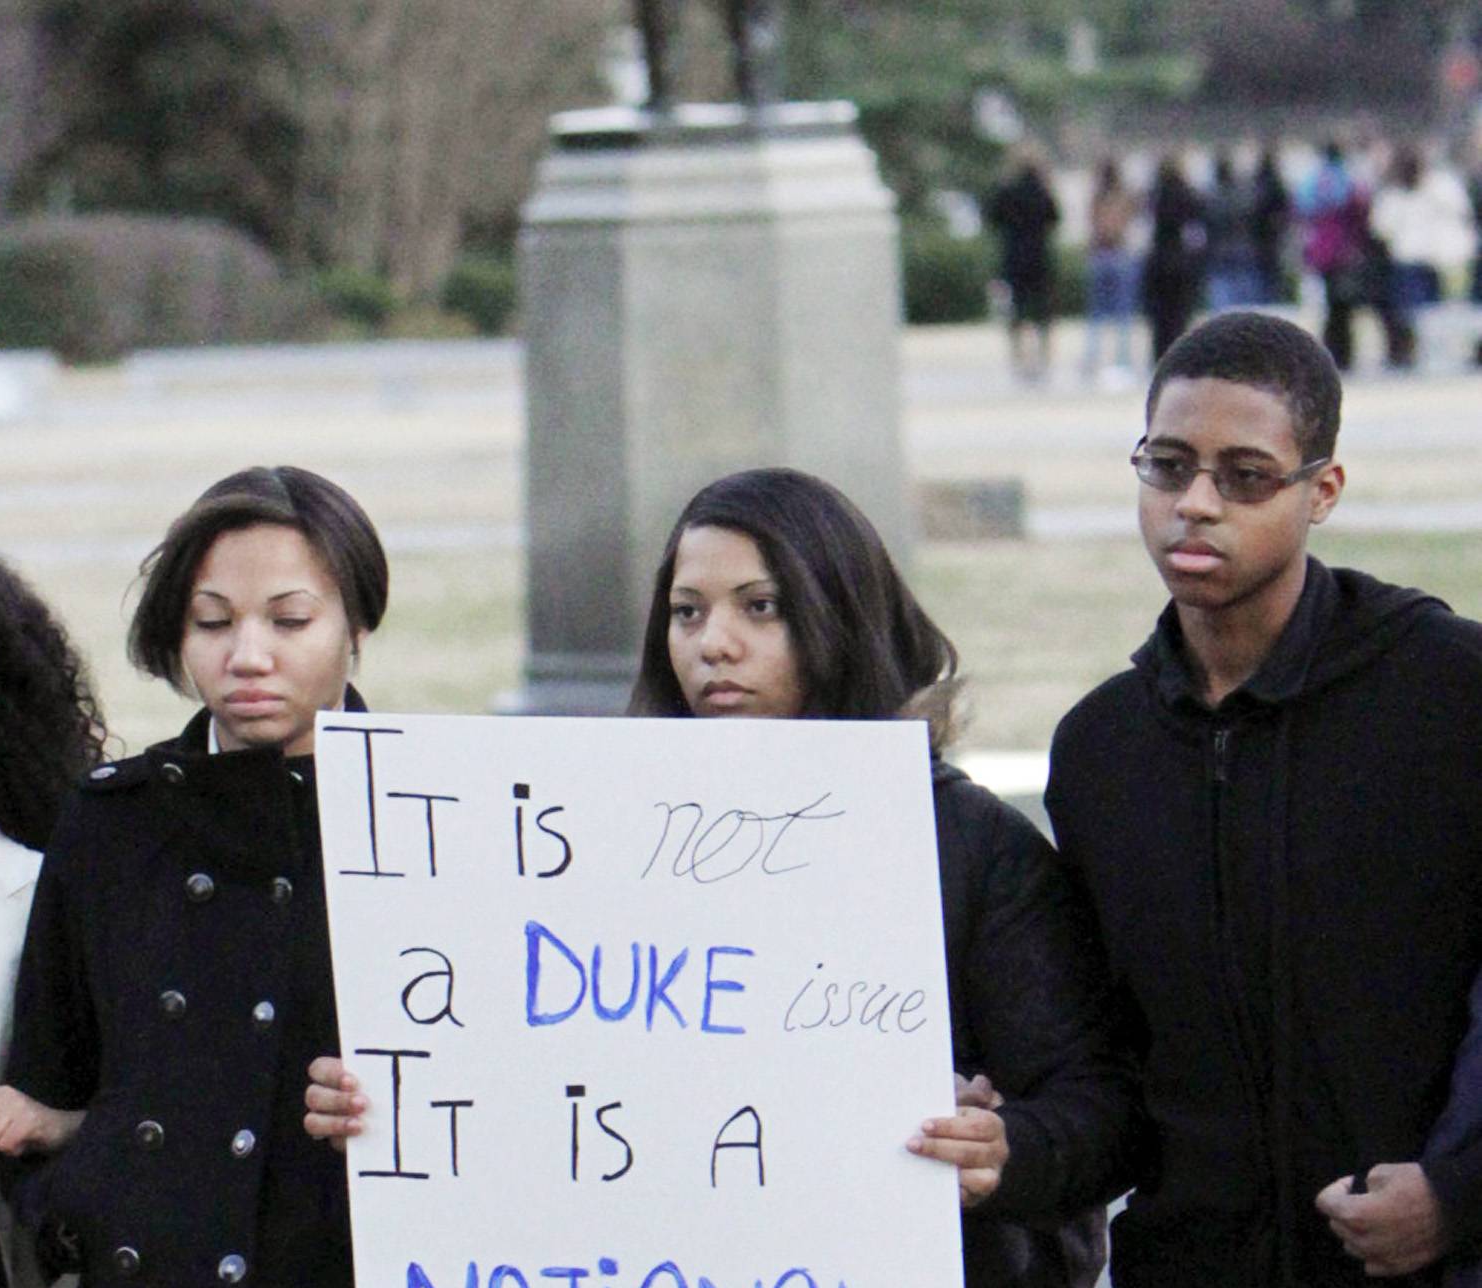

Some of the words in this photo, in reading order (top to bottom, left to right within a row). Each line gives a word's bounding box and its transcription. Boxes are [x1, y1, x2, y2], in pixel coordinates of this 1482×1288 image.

[512, 783, 573, 877] is
[640, 793, 845, 883] not
[400, 947, 464, 1027] a
[524, 920, 755, 1034] DUKE
[784, 963, 927, 1034] issue
[566, 1085, 633, 1181] is
[710, 1105, 765, 1187] A
